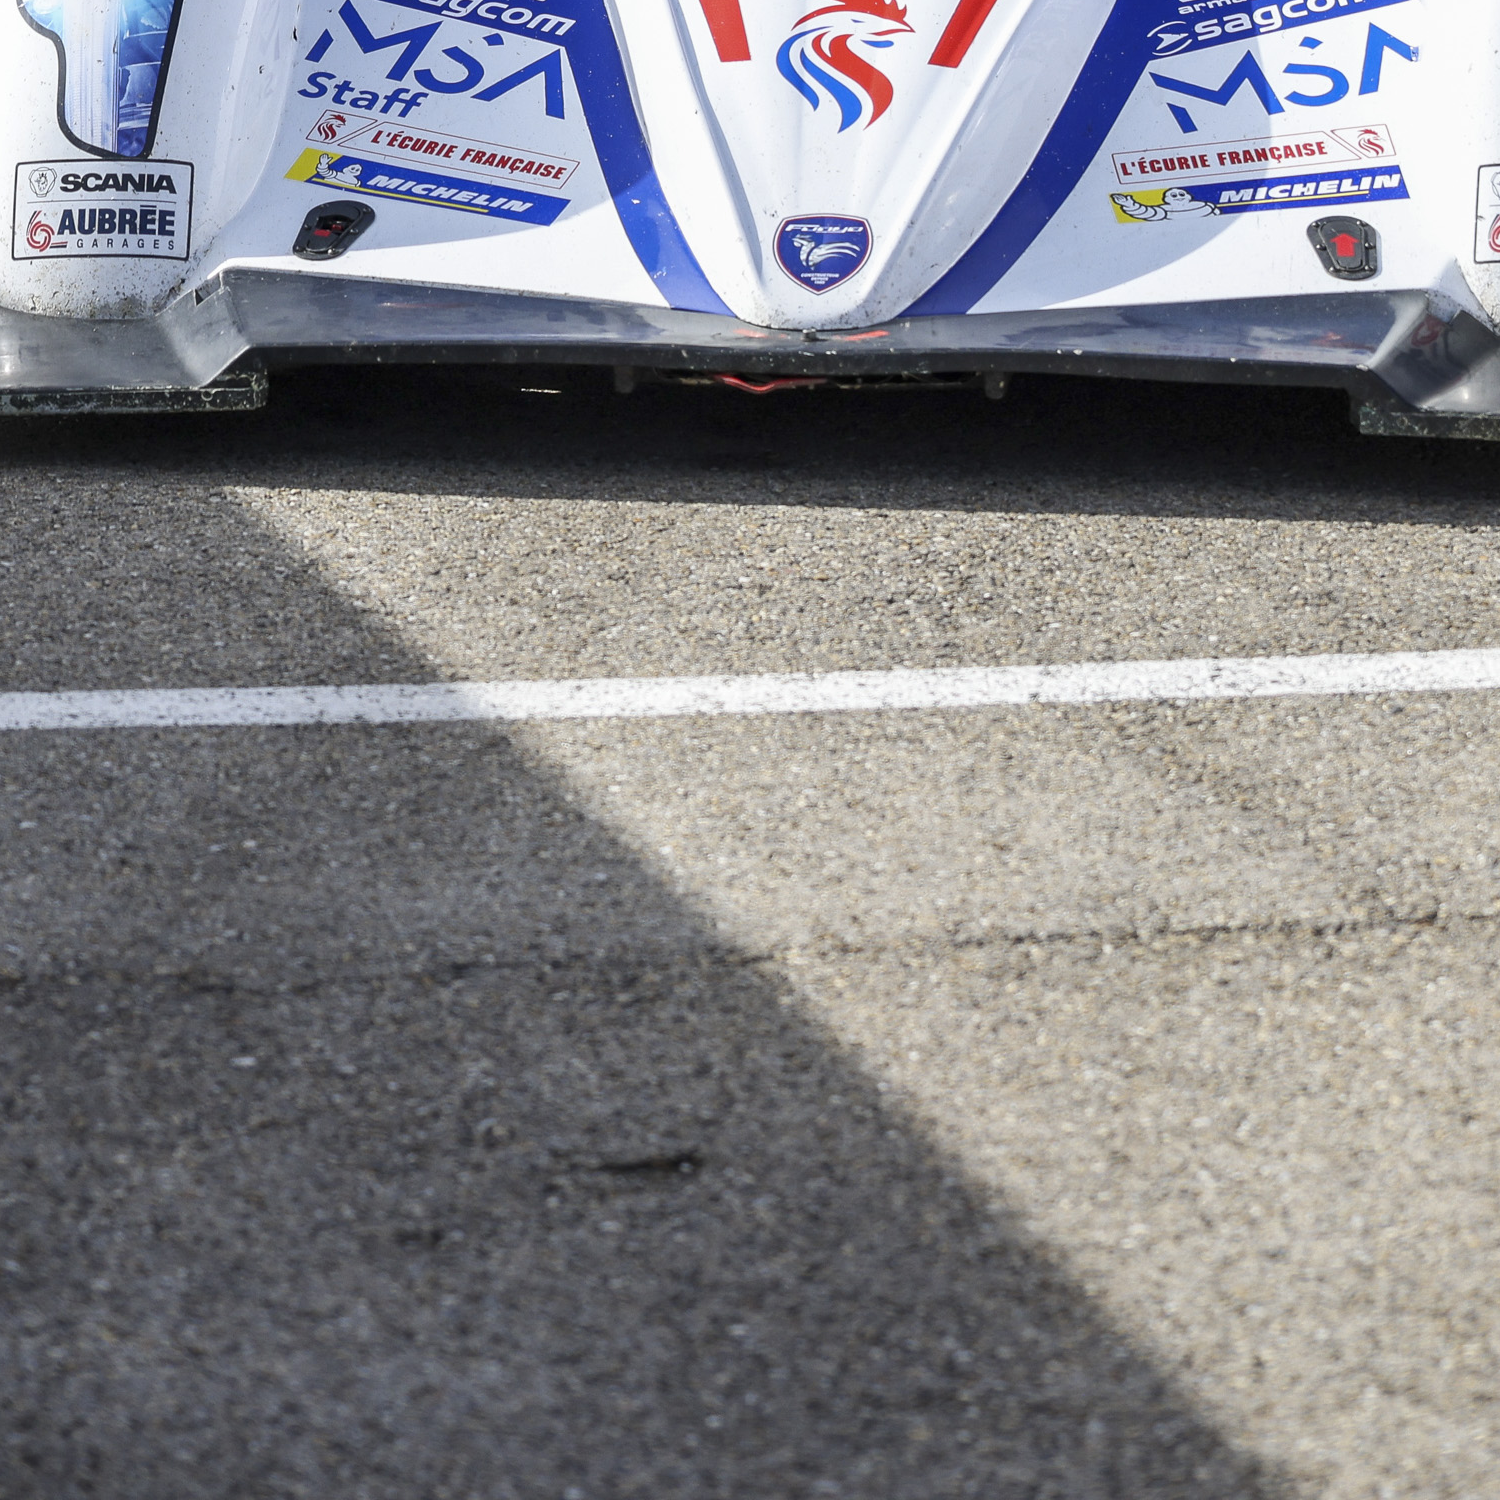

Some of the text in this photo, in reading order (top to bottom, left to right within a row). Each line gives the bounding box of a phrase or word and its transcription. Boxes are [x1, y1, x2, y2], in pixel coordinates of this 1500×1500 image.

[297, 71, 429, 118] Staff
[1148, 22, 1420, 133] MSA
[371, 130, 567, 181] L'ÉCURIE FRANÇAISE
[1120, 141, 1328, 177] L'ÉCURIE FRANÇAISE
[60, 173, 177, 194] SCANIA
[366, 174, 534, 213] MICHELIN
[1219, 173, 1402, 204] MICHELIN
[76, 238, 175, 250] GARAGES
